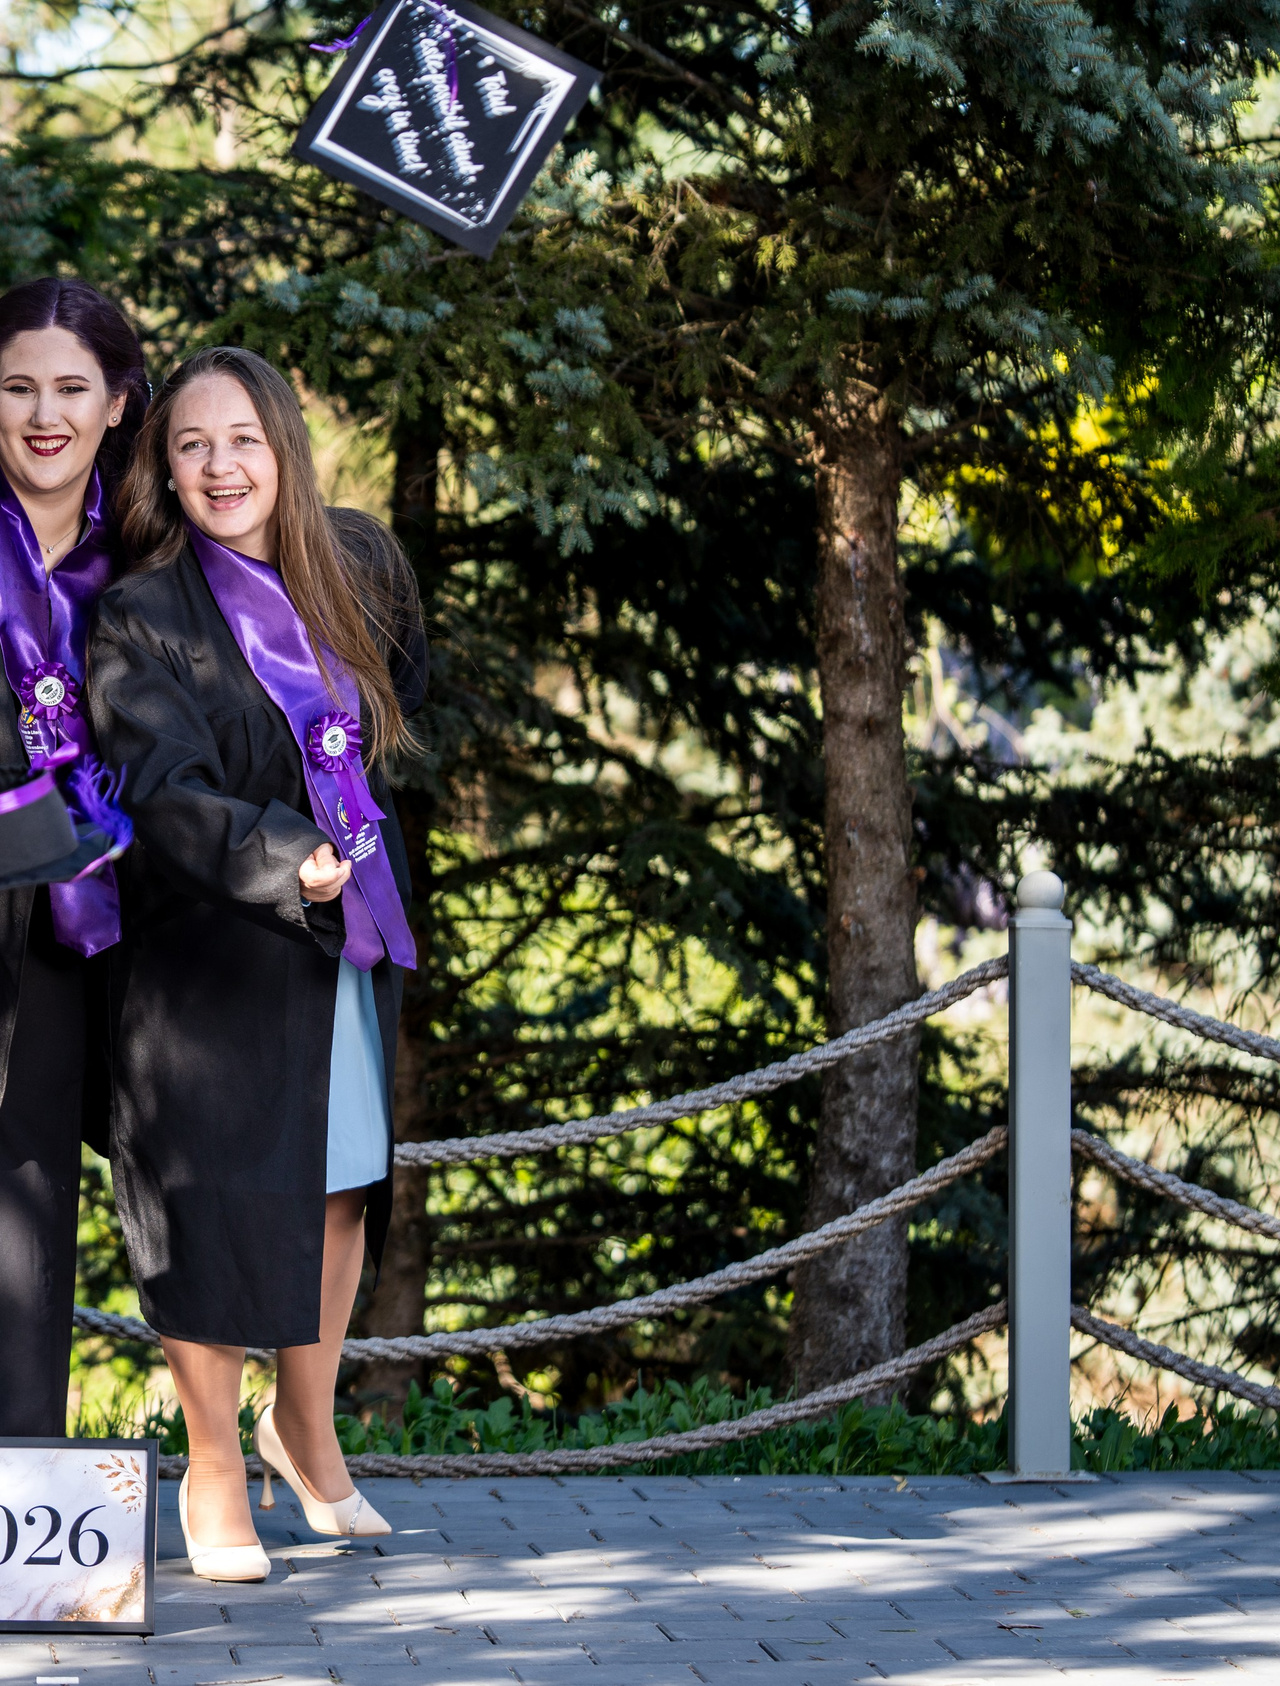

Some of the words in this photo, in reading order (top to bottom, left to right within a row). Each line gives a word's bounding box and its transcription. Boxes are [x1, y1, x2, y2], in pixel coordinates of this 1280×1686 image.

[416, 38, 447, 75] este
[358, 68, 408, 111] crezi
[414, 73, 470, 130] posibil
[476, 70, 517, 117] Totul
